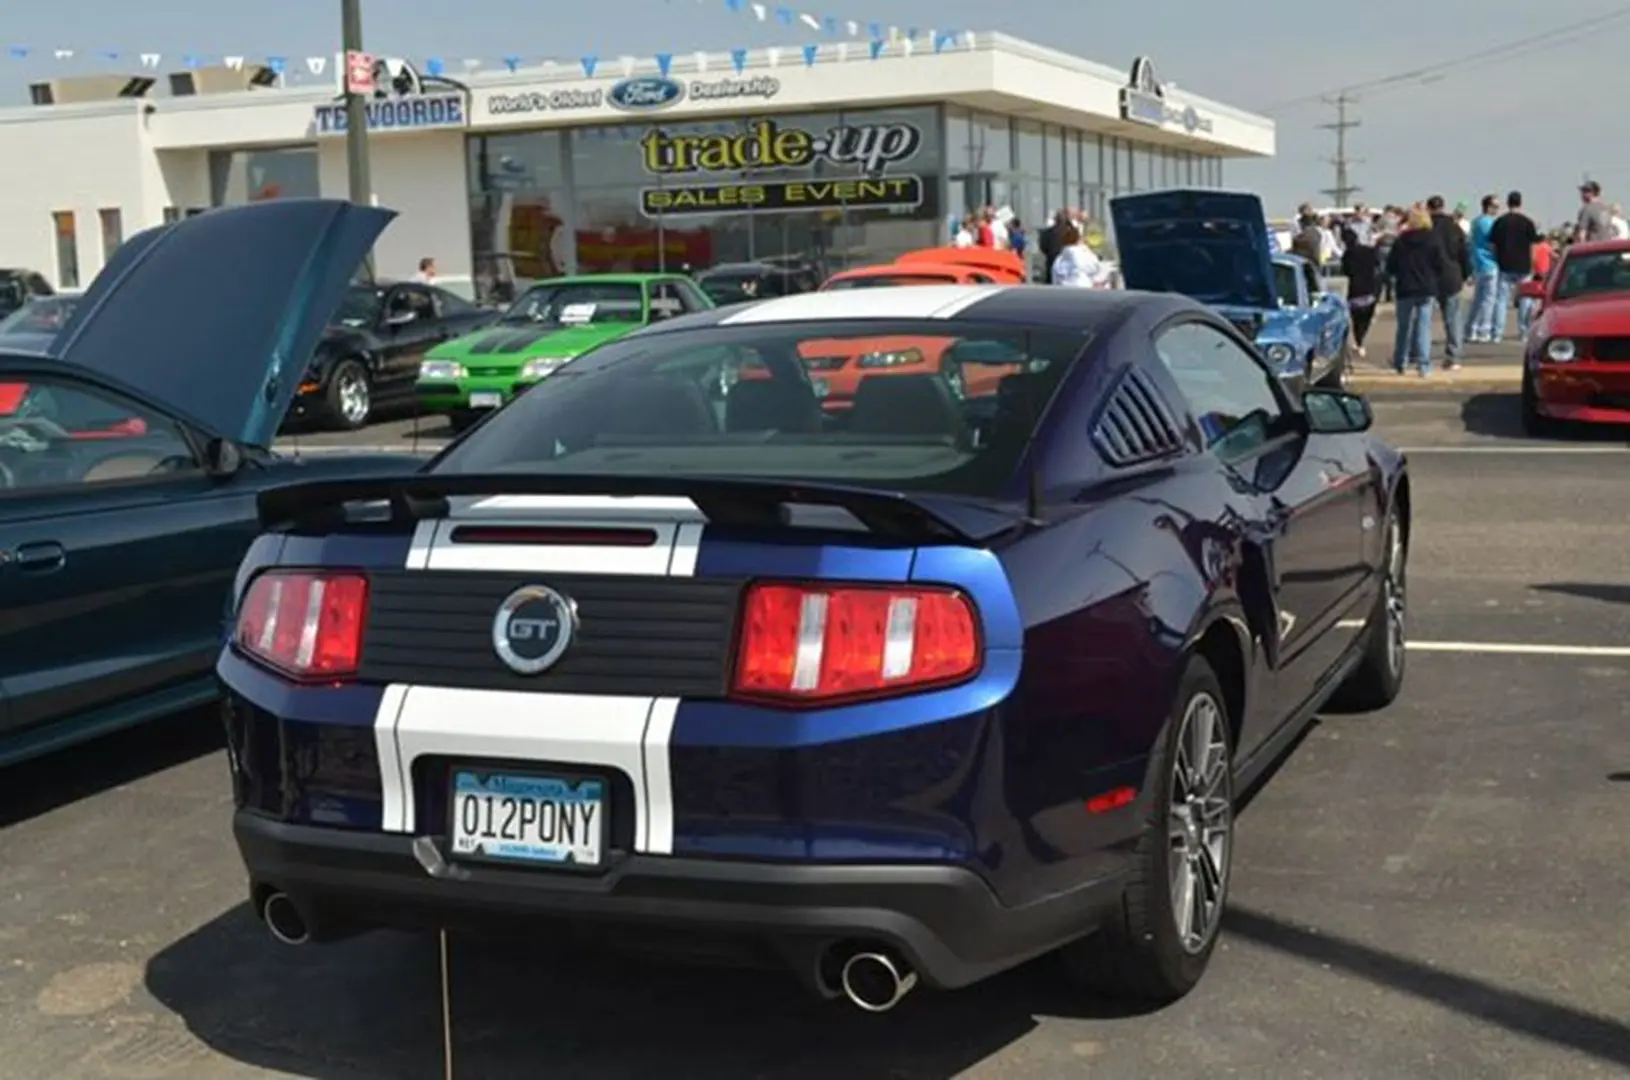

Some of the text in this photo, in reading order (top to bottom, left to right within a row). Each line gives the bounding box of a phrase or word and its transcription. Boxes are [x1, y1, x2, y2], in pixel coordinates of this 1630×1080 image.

[549, 88, 602, 110] Oldest
[622, 81, 669, 104] Ford
[689, 76, 780, 101] Dealership
[315, 97, 462, 132] TEVOORDE
[647, 178, 911, 207] SALES EVENT
[510, 618, 557, 640] GT
[462, 794, 595, 847] 012PONY
